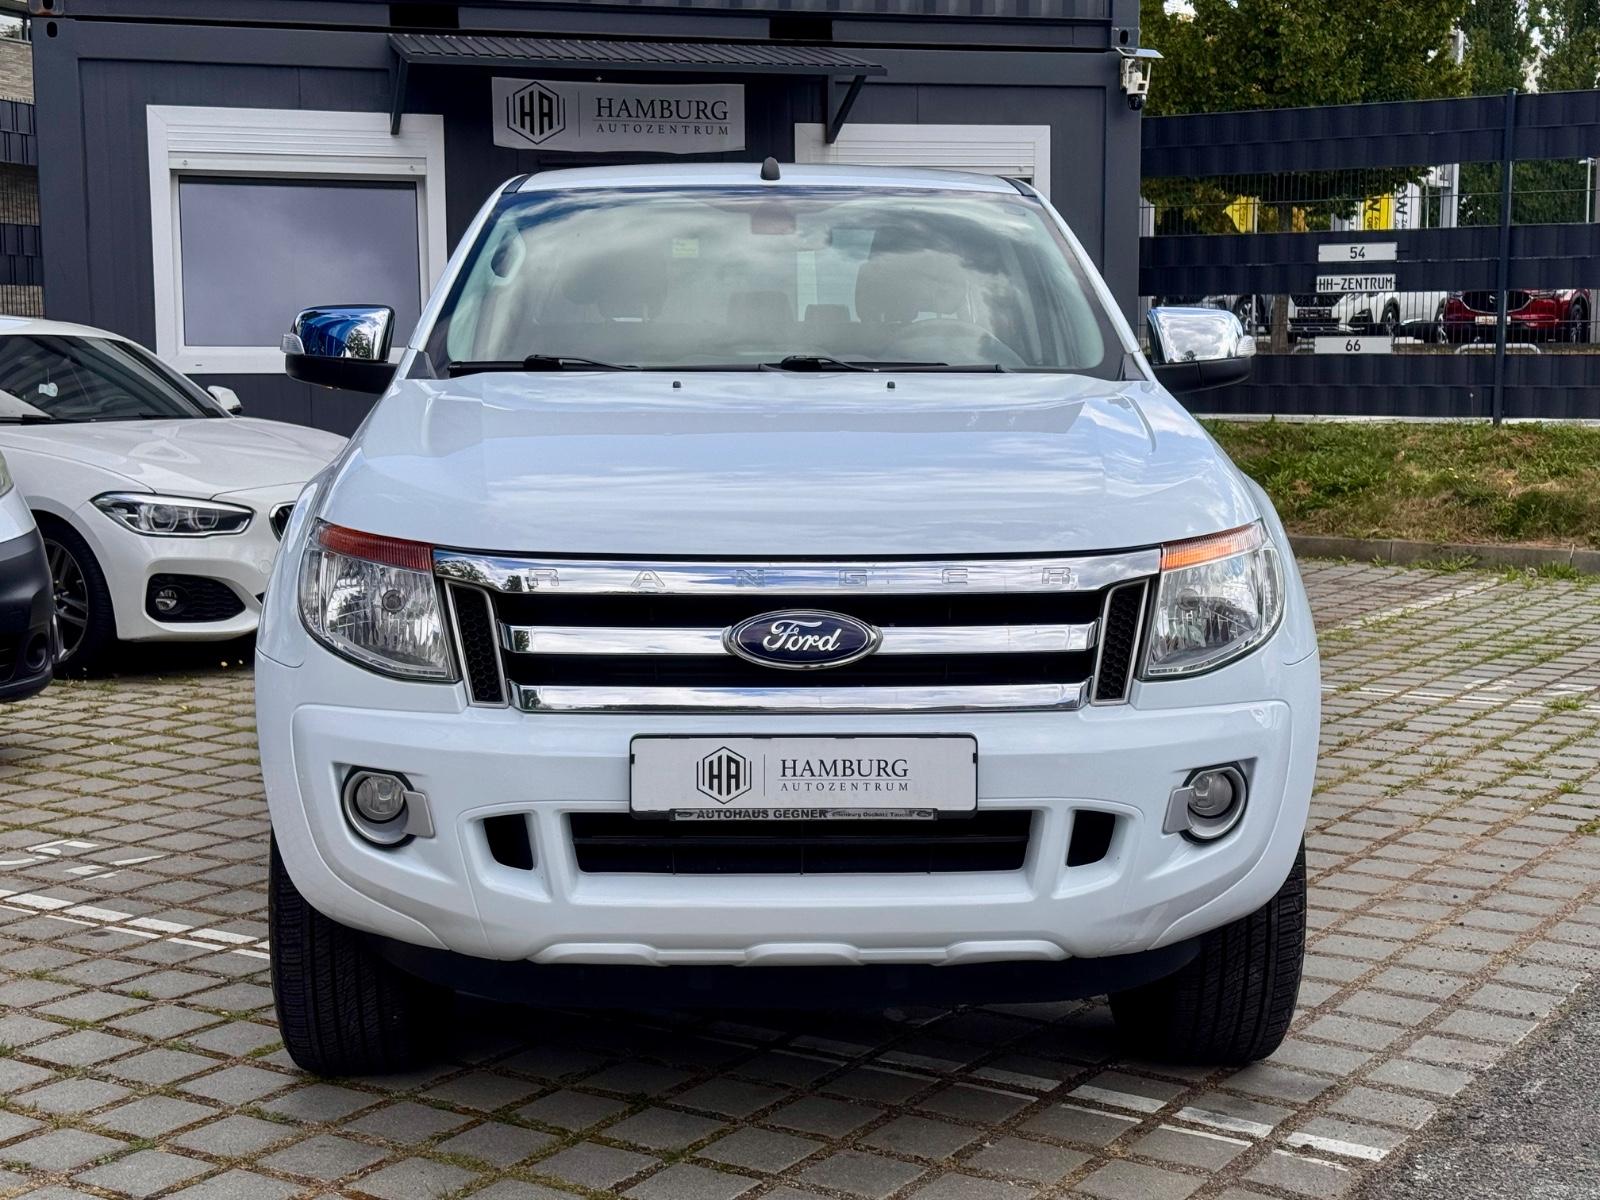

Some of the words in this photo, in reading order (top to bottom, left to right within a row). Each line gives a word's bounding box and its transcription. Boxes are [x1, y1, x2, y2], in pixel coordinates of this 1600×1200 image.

[595, 97, 729, 121] HAMBURG
[596, 123, 730, 136] AUTOZENTRUM
[1349, 246, 1366, 259] 54
[1318, 277, 1393, 291] HH-ZENTRUM
[1345, 339, 1361, 352] 66
[527, 566, 1073, 588] RANGER
[762, 619, 842, 651] Ford
[780, 758, 909, 778] HAMBURG
[780, 782, 909, 792] AUTOZENTRUM
[696, 808, 769, 819] AUTOHAUS
[773, 808, 829, 819] GEGNER
